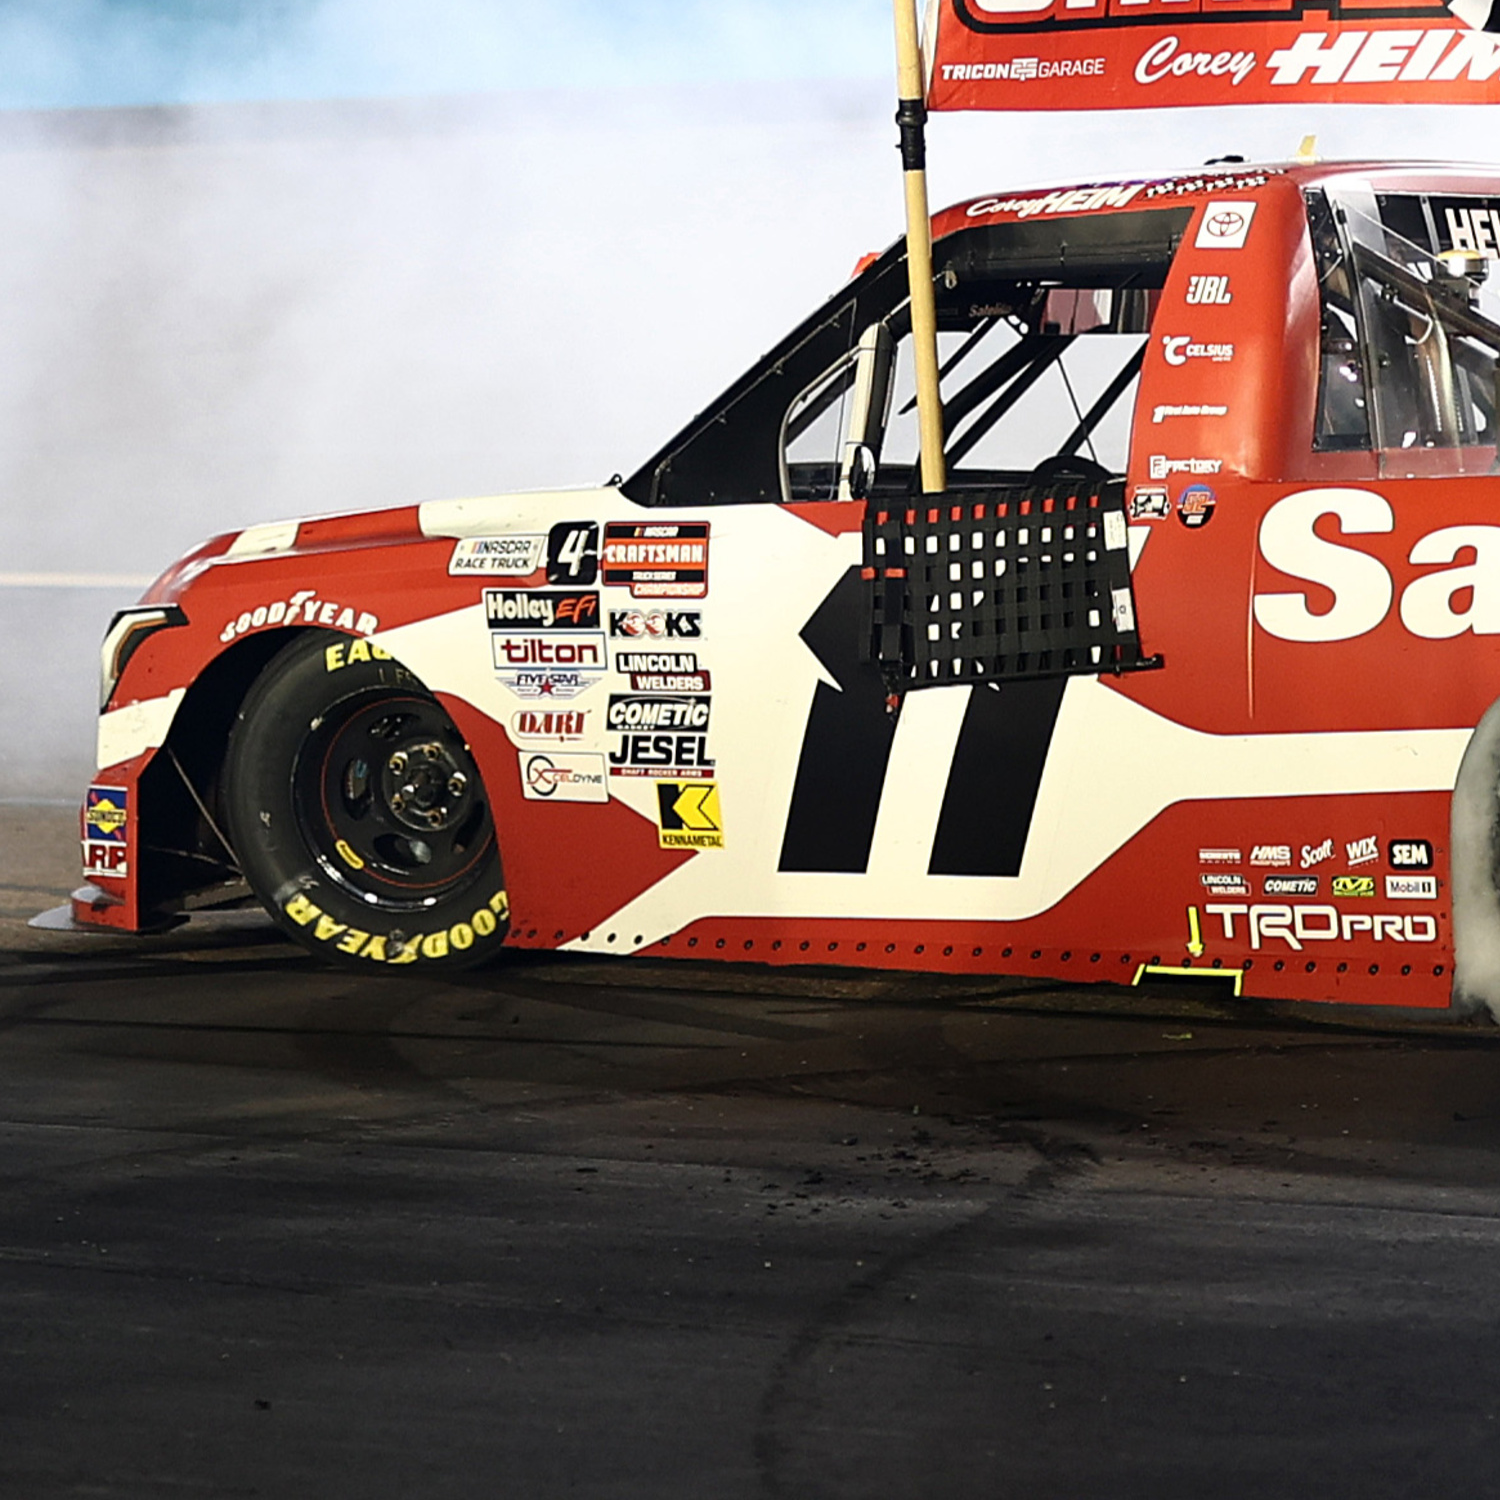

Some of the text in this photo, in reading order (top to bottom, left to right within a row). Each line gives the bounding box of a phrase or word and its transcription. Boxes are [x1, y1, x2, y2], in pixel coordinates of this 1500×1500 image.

[941, 58, 1105, 80] TRICON GARAGE
[1135, 35, 1258, 85] Corey
[1032, 184, 1147, 214] HEIM
[1187, 276, 1232, 304] JBL
[1185, 344, 1234, 357] CELSIUS
[1166, 458, 1222, 474] FACTORY
[481, 540, 531, 554] NASCAR
[556, 530, 589, 576] 4
[606, 544, 703, 563] CRAFTSMAN
[454, 557, 530, 569] RACE TRUCK
[220, 591, 379, 642] GOODYEAR
[487, 594, 554, 626] Holley
[326, 639, 393, 672] EAG
[501, 639, 599, 663] tilton
[619, 654, 694, 672] LINCOLN
[517, 674, 579, 685] FIVE STAR
[636, 676, 704, 690] WELDERS
[609, 701, 708, 726] COMETIC
[609, 735, 711, 766] JESEL
[662, 834, 723, 847] KENNAMETAL
[1346, 836, 1378, 860] WIX
[81, 846, 126, 869] RP
[1250, 846, 1291, 859] HMS
[1392, 844, 1428, 865] SEM
[1202, 875, 1242, 885] LINCOLN
[1264, 879, 1317, 893] COMETIC
[1390, 881, 1420, 893] Mobil
[285, 890, 511, 964] GOODYEAR
[1205, 904, 1437, 950] TRD PRO
